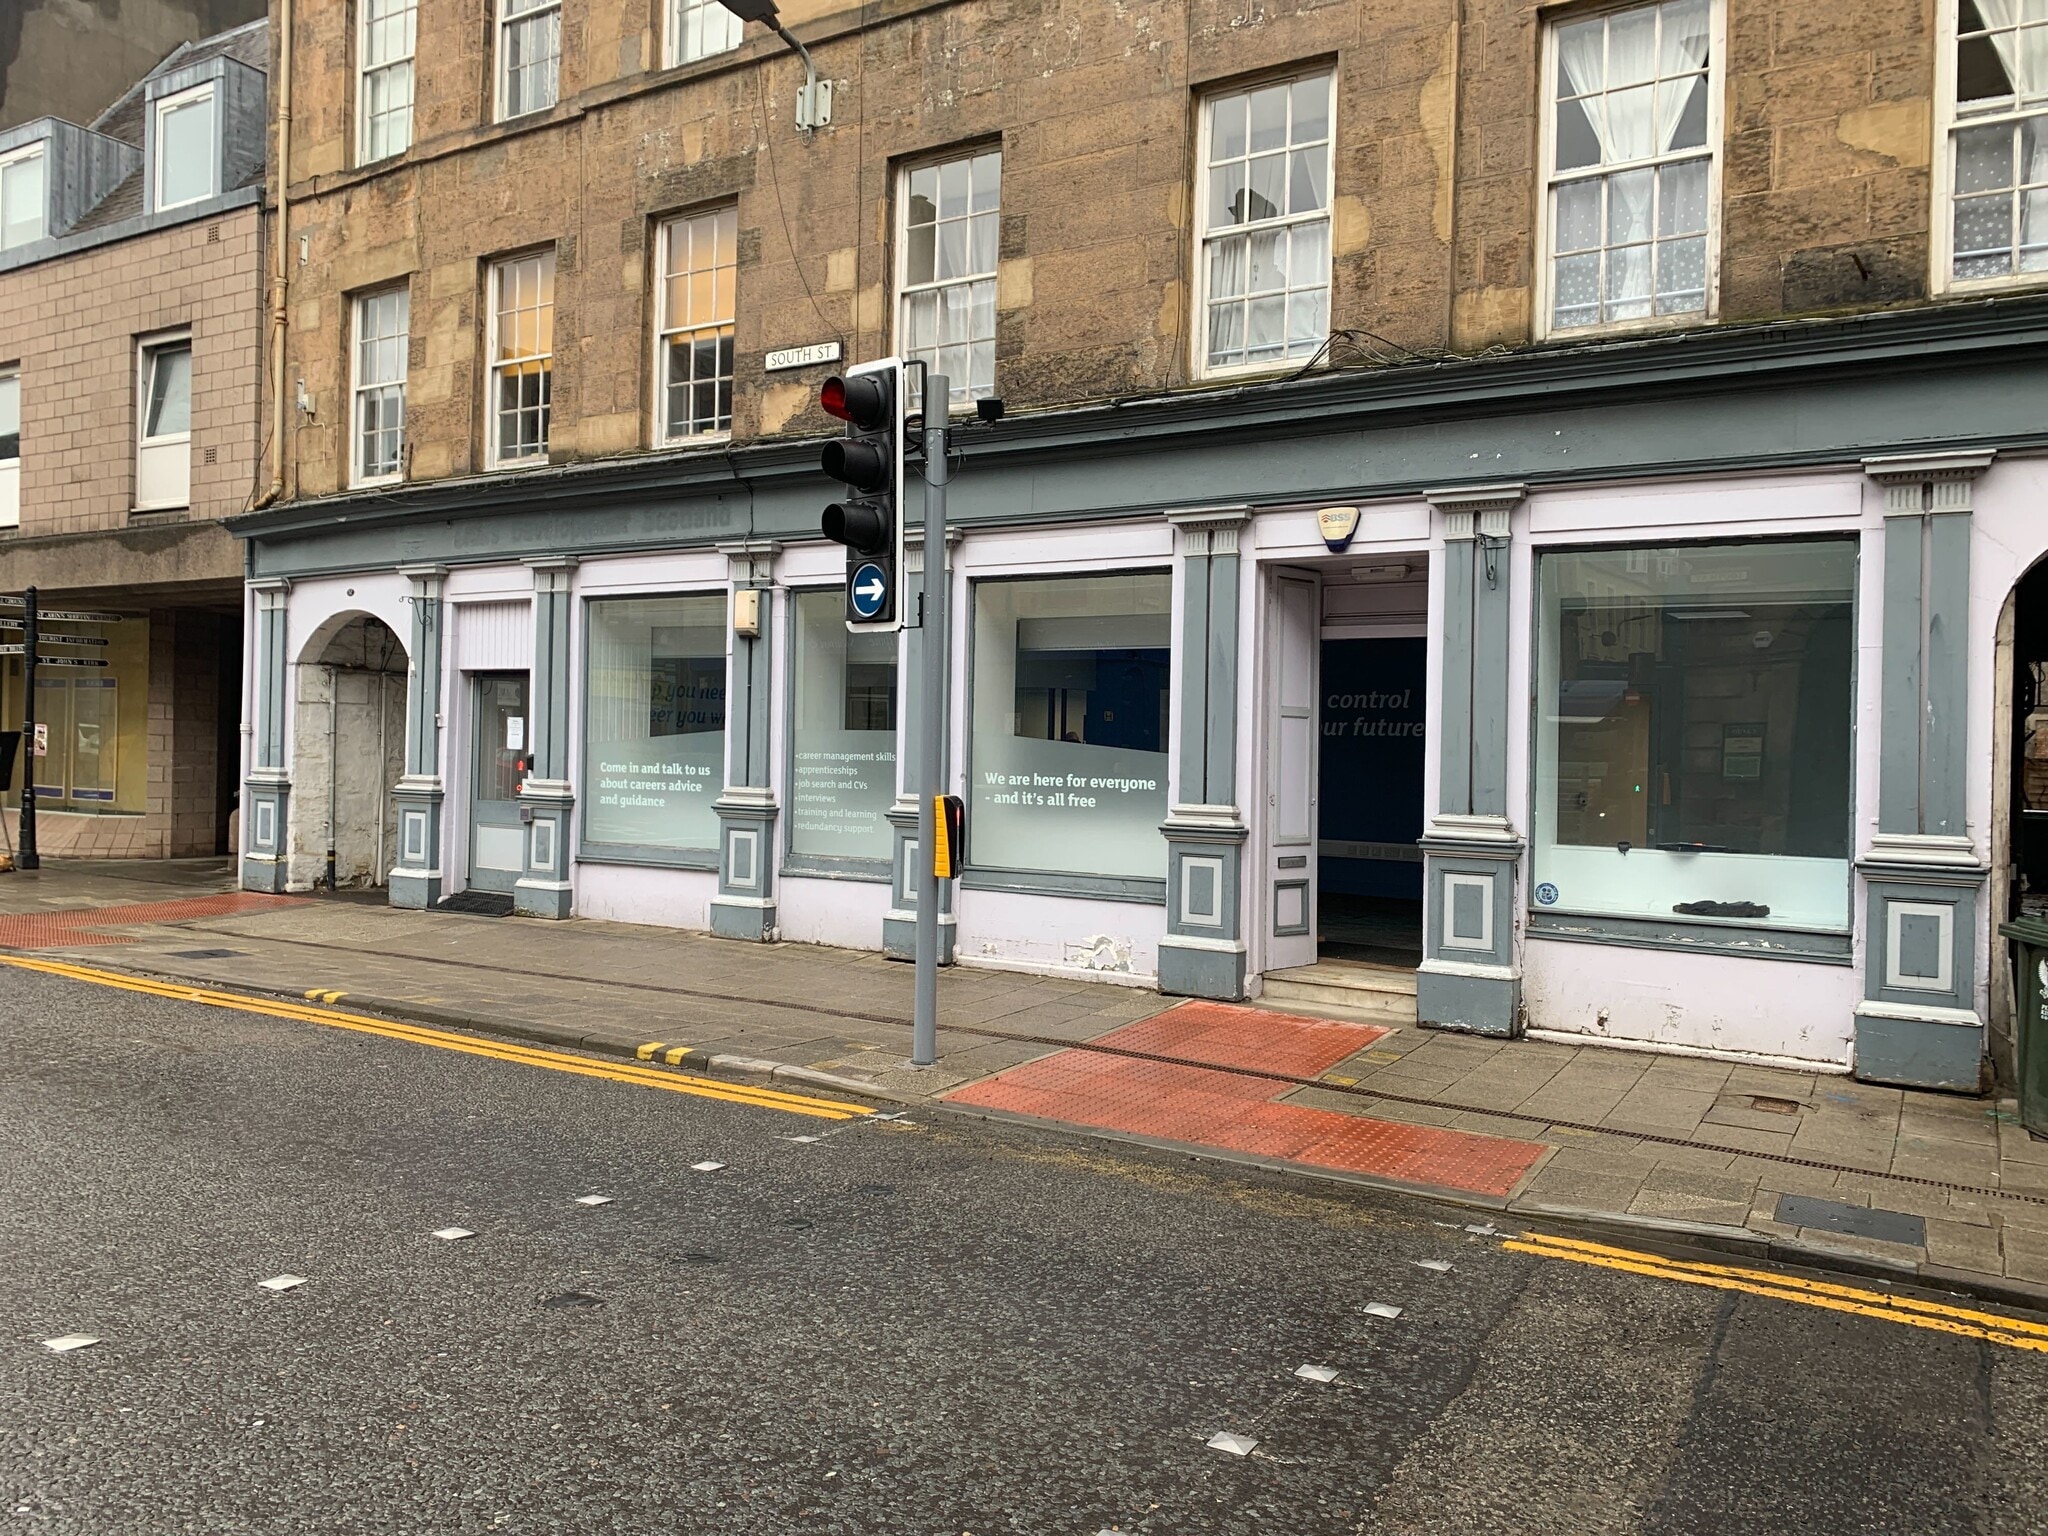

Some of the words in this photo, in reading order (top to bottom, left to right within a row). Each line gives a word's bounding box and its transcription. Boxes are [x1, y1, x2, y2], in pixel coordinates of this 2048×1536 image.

[771, 348, 811, 366] SOUTH
[1327, 688, 1411, 709] control
[676, 711, 705, 728] you
[1352, 717, 1425, 737] future
[798, 752, 821, 760] career
[823, 752, 874, 762] management
[875, 751, 896, 761] skills
[600, 761, 627, 773] Come
[630, 761, 639, 773] in
[641, 762, 661, 774] and
[662, 762, 683, 775] talk
[685, 764, 695, 775] to
[698, 766, 711, 776] us
[798, 765, 858, 776] apprenticeships
[600, 777, 628, 789] about
[630, 780, 667, 790] careers
[669, 780, 703, 792] advice
[798, 779, 810, 790] job
[811, 780, 836, 789] search
[837, 781, 852, 789] and
[853, 781, 868, 790] CVs
[984, 772, 1005, 785] We
[1008, 775, 1030, 785] are
[1033, 772, 1064, 787] here
[1066, 774, 1087, 788] for
[1090, 777, 1156, 792] everyone
[600, 794, 618, 805] and
[620, 794, 665, 808] guidance
[797, 793, 836, 803] interviews
[993, 791, 1019, 804] and
[1022, 792, 1044, 805] it's
[1047, 793, 1065, 806] all
[1068, 793, 1097, 808] free
[798, 808, 828, 819] training
[829, 809, 844, 818] and
[845, 809, 877, 822] learning
[798, 822, 842, 834] redundancy
[843, 825, 874, 835] support
